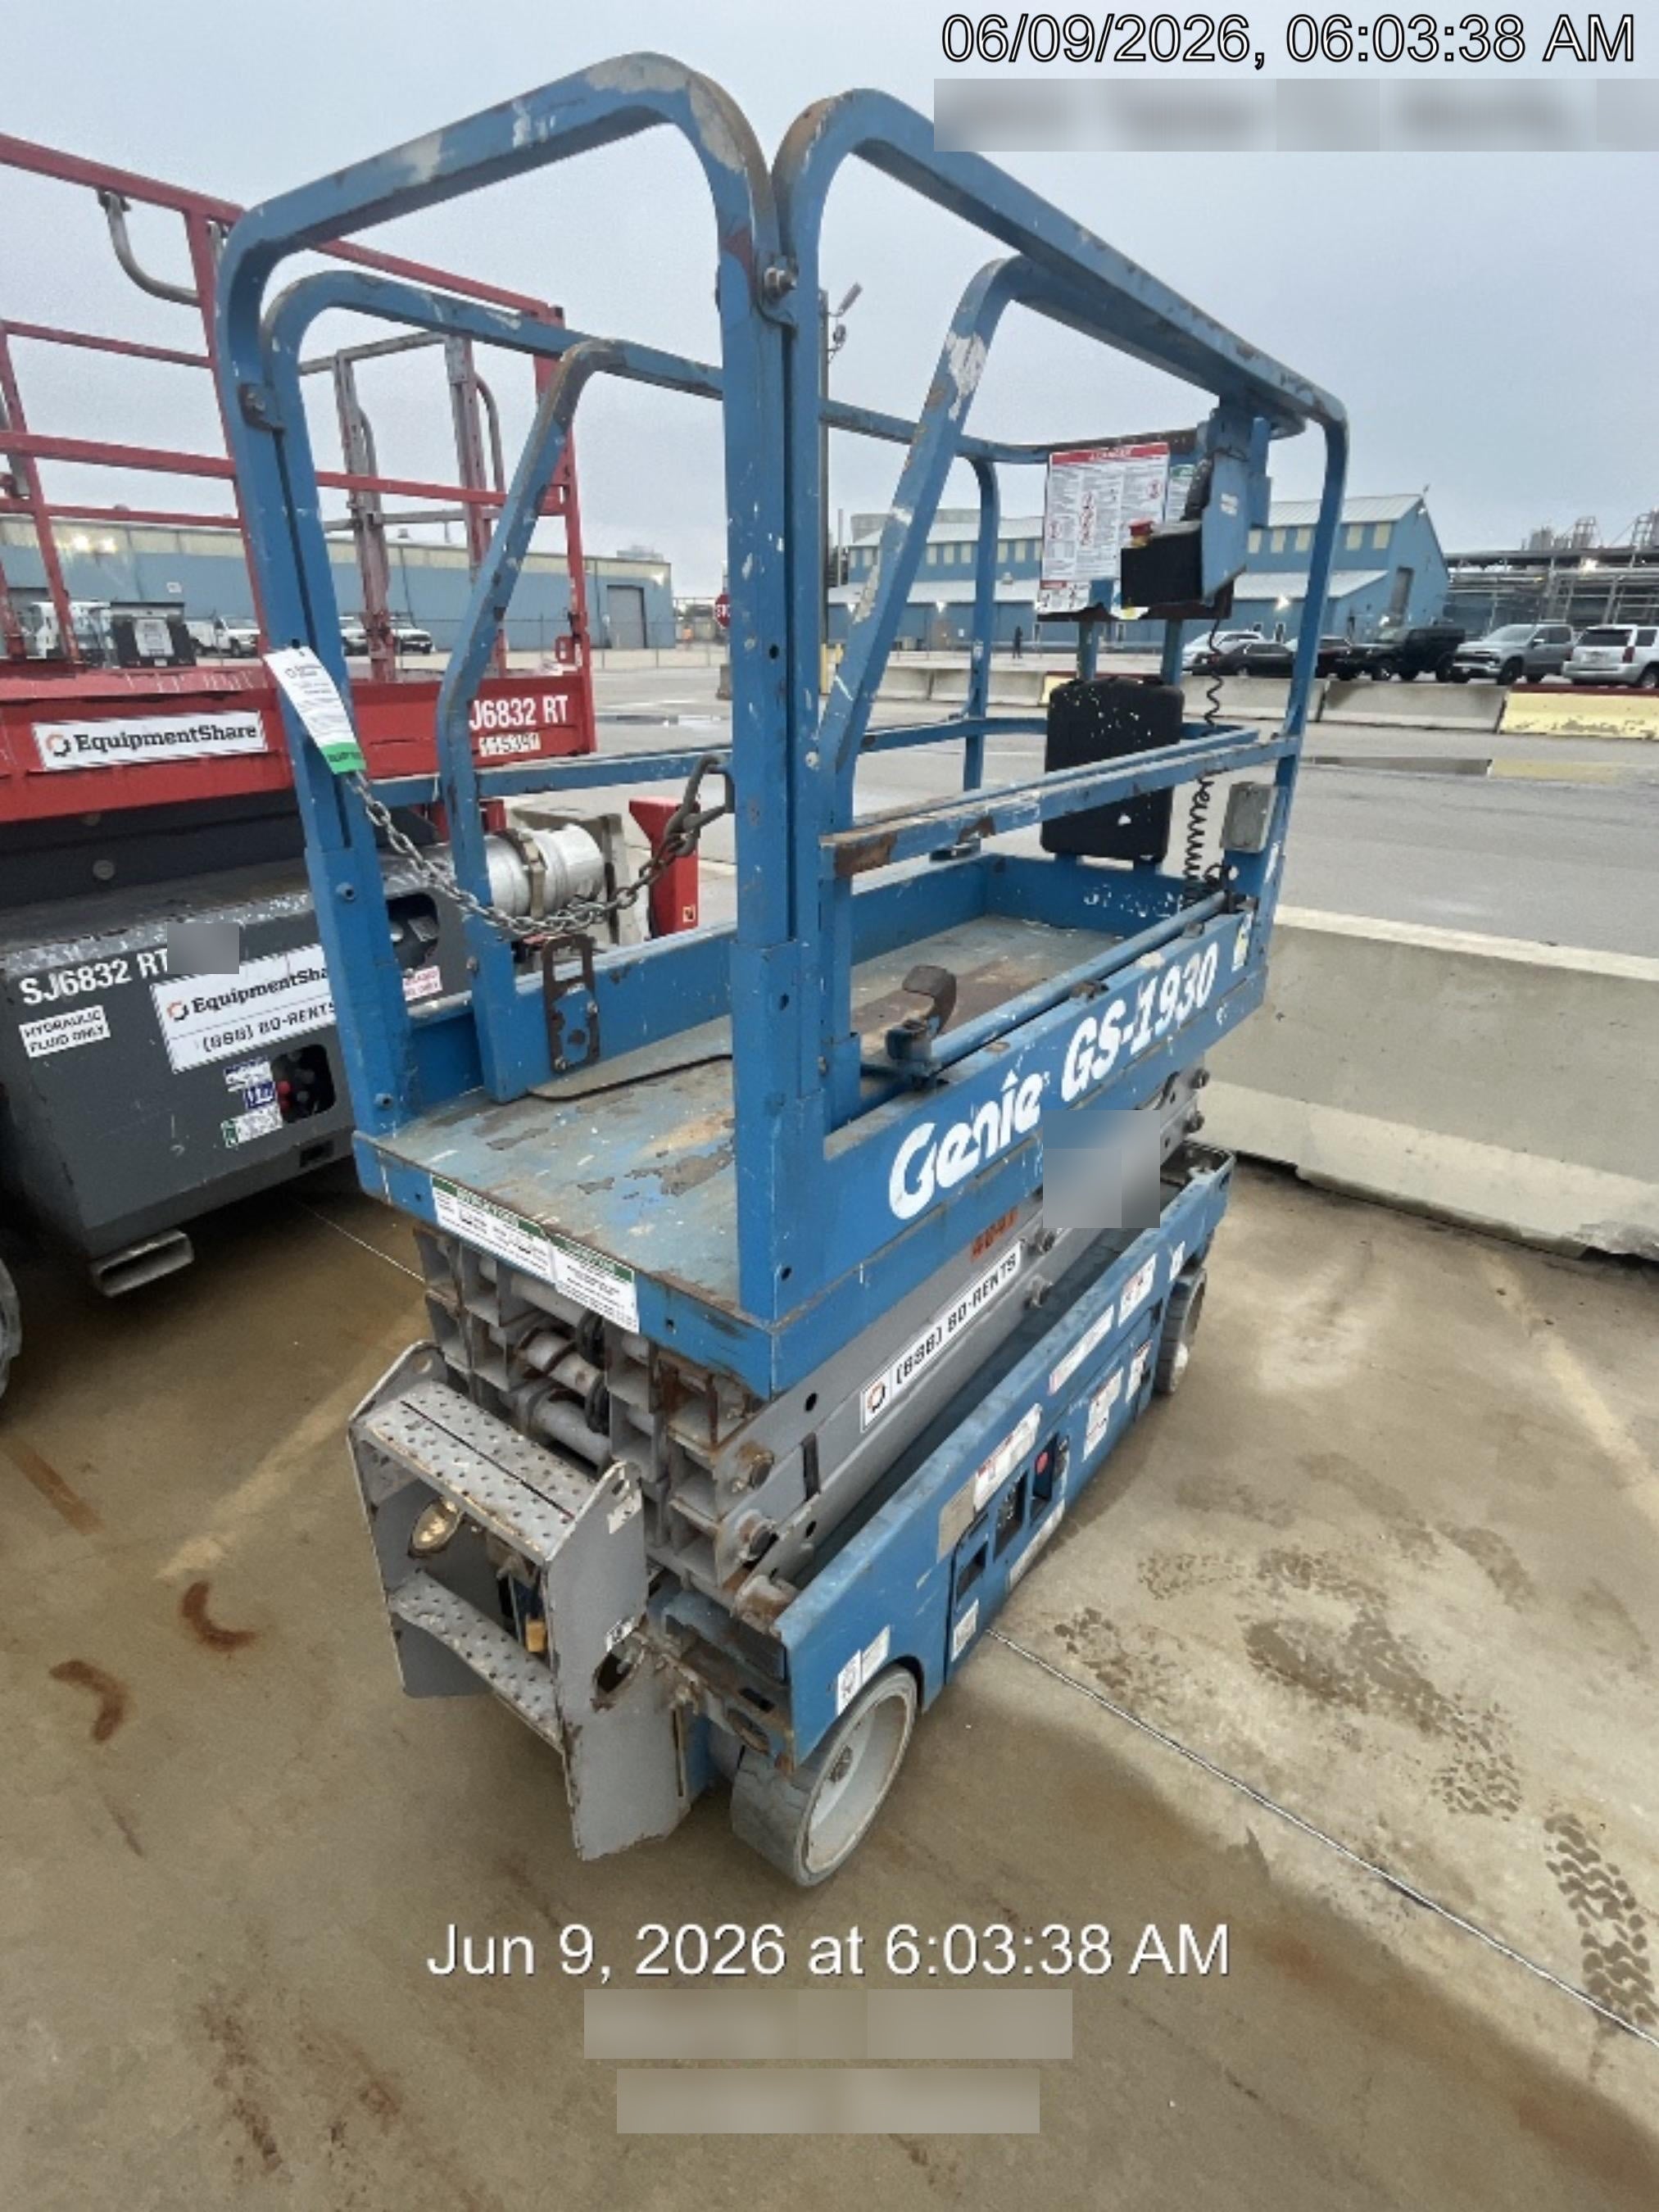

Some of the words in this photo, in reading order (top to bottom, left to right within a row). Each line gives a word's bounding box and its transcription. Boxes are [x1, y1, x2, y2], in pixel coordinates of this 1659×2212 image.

[469, 696, 537, 730] J6832
[542, 695, 569, 723] RT
[73, 724, 256, 753] EquipmentShare
[19, 958, 132, 1004] SJ6832
[137, 948, 168, 978] RT
[191, 968, 329, 1013] EquipmentSha
[29, 1034, 69, 1053] FLUID
[889, 1068, 1044, 1220] Genie
[1061, 941, 1218, 1102] GS-1930
